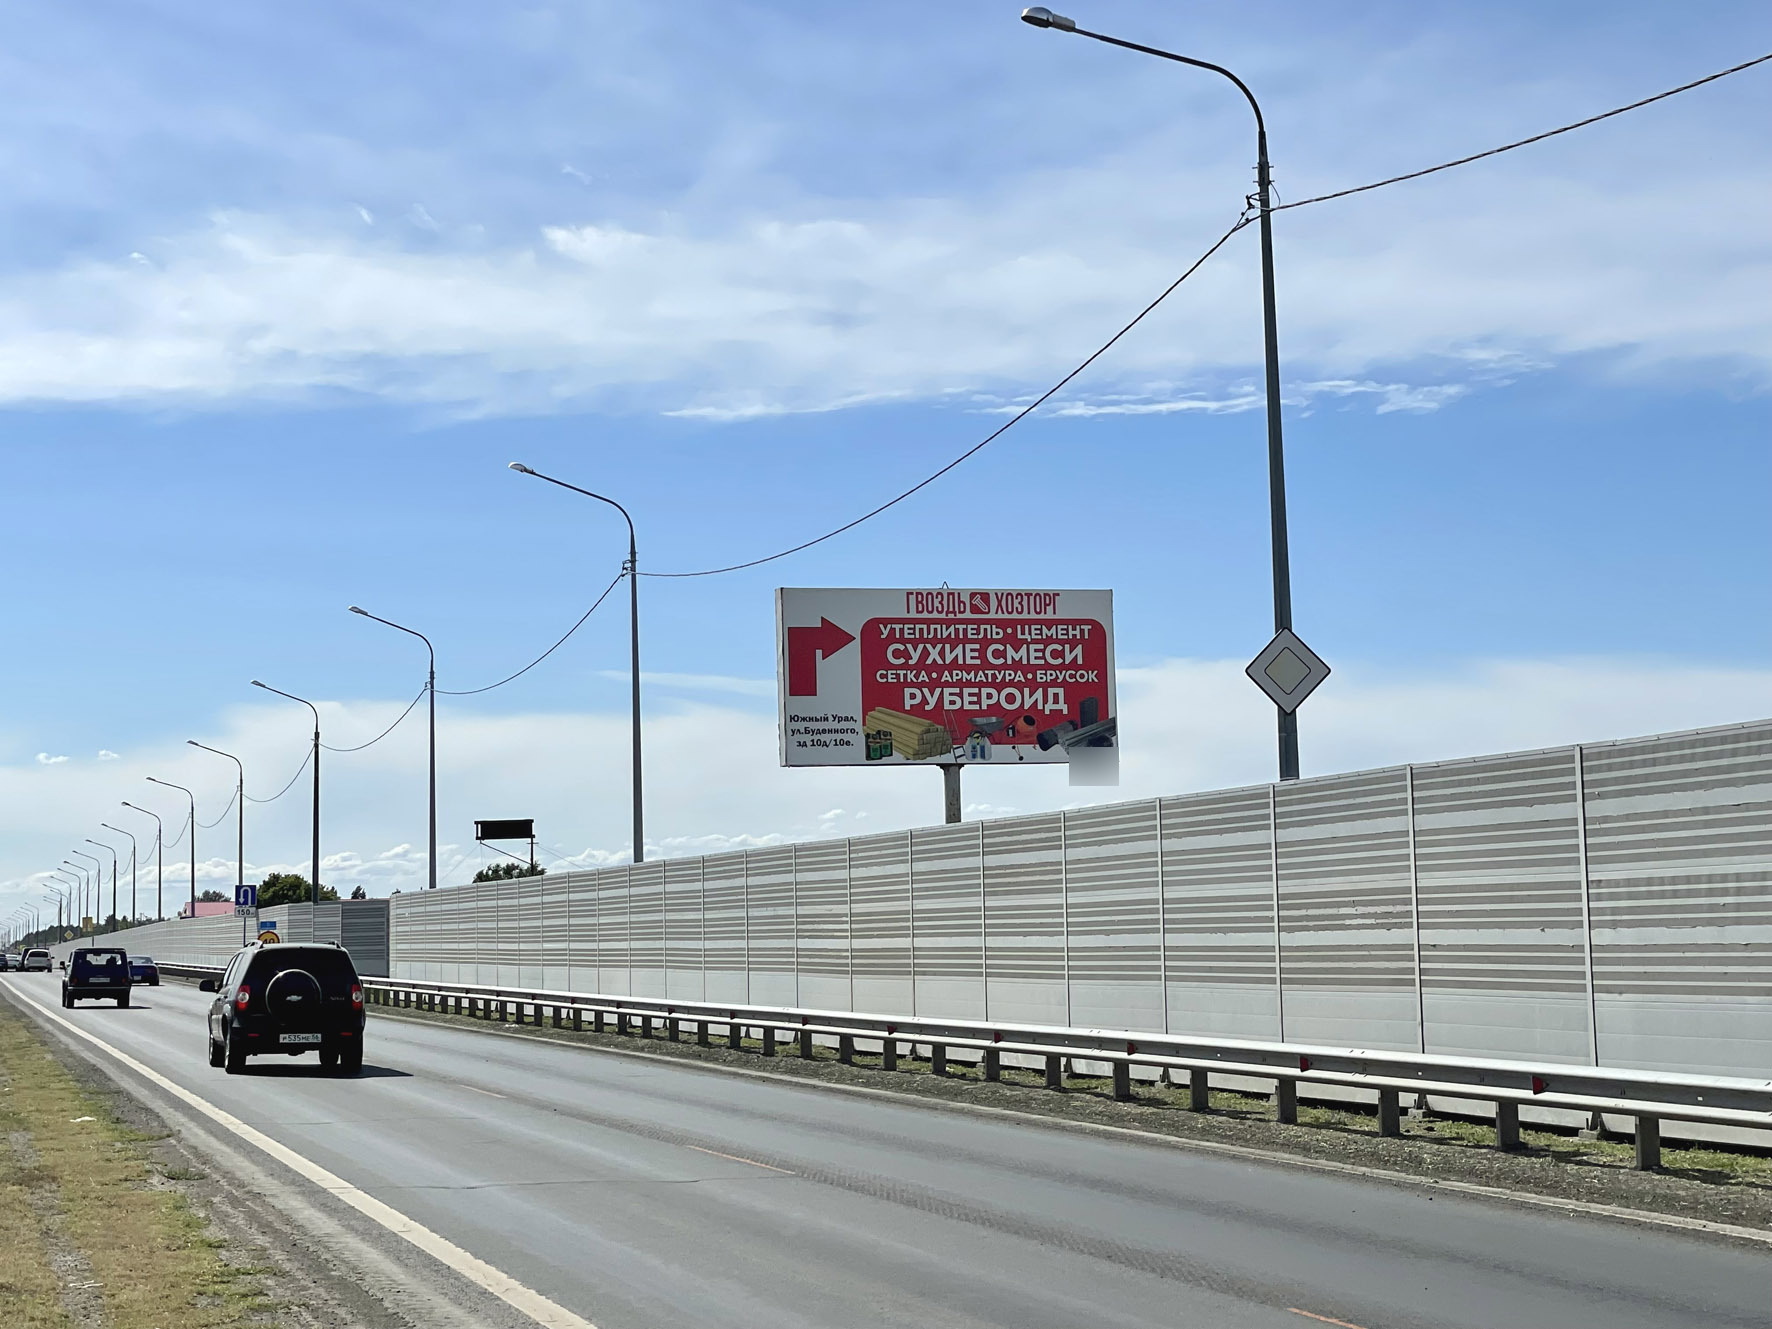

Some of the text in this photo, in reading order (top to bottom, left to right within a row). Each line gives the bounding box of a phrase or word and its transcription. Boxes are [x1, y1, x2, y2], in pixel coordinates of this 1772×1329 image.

[905, 592, 1060, 617] ГВОЗДЬ ХОЗТОРГ
[879, 624, 1092, 641] УТЕПЛИТЕЛЬ ЦЕМЕНТ
[886, 643, 1083, 665] СУХИЕ СМЕСИ
[876, 670, 1099, 683] СЕТКА АРМАТУРА БРУСОК
[903, 687, 1068, 715] РУБЕРОИД
[789, 713, 857, 724] Южный Урал,
[790, 726, 859, 737] ул.Буденного,
[237, 908, 251, 916] 150
